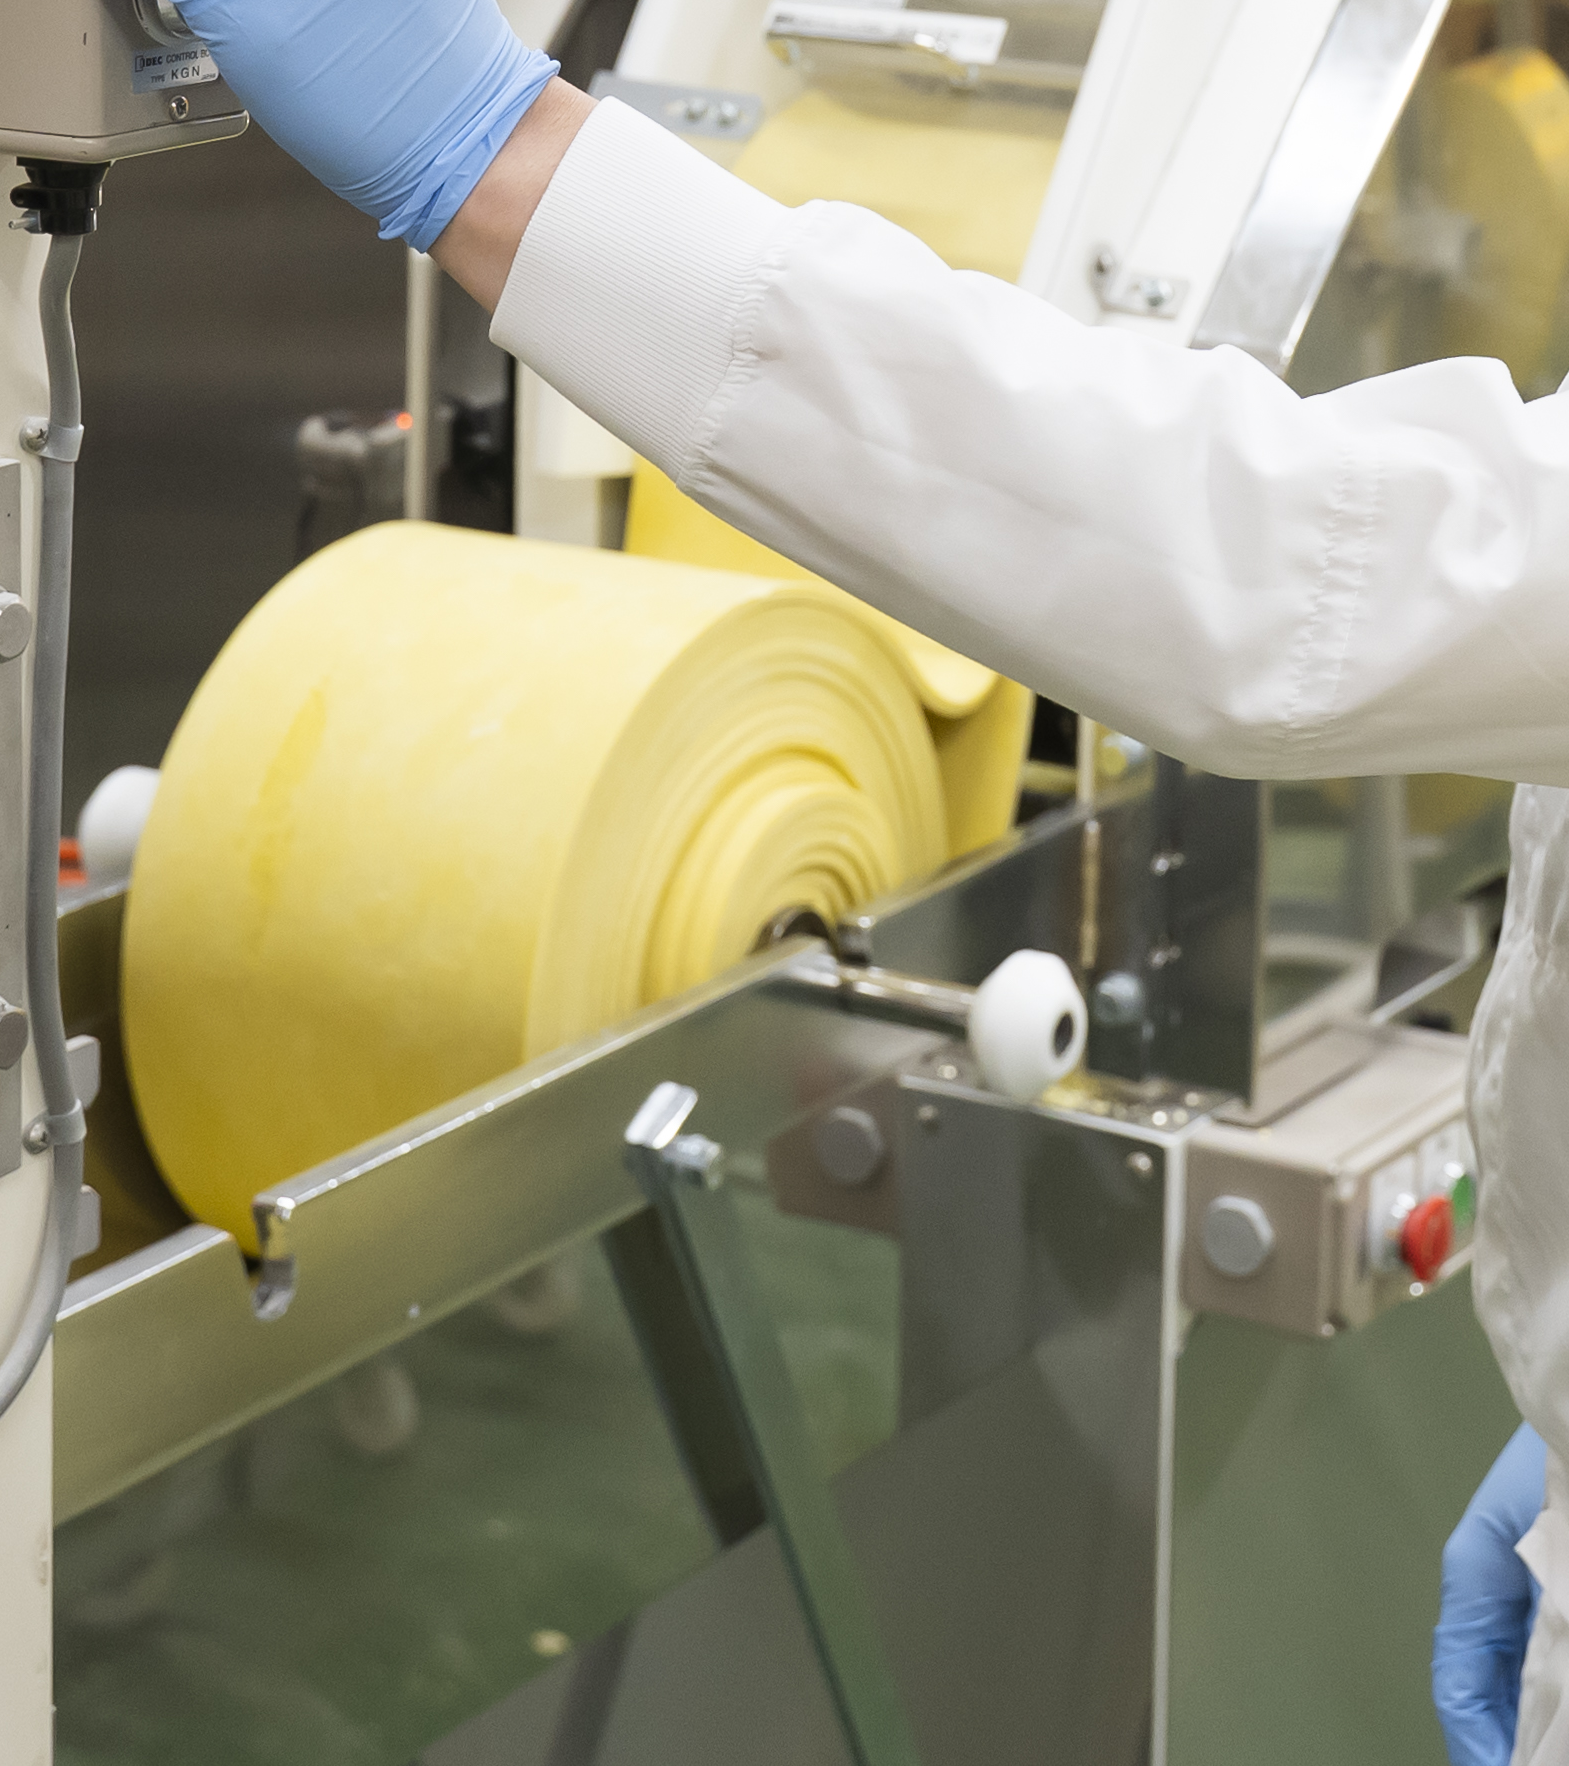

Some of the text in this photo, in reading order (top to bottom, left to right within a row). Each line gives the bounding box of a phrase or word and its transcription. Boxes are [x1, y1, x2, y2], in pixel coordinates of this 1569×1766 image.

[166, 50, 199, 64] CONTROL
[151, 75, 166, 84] TYPE
[171, 65, 200, 80] KGN
